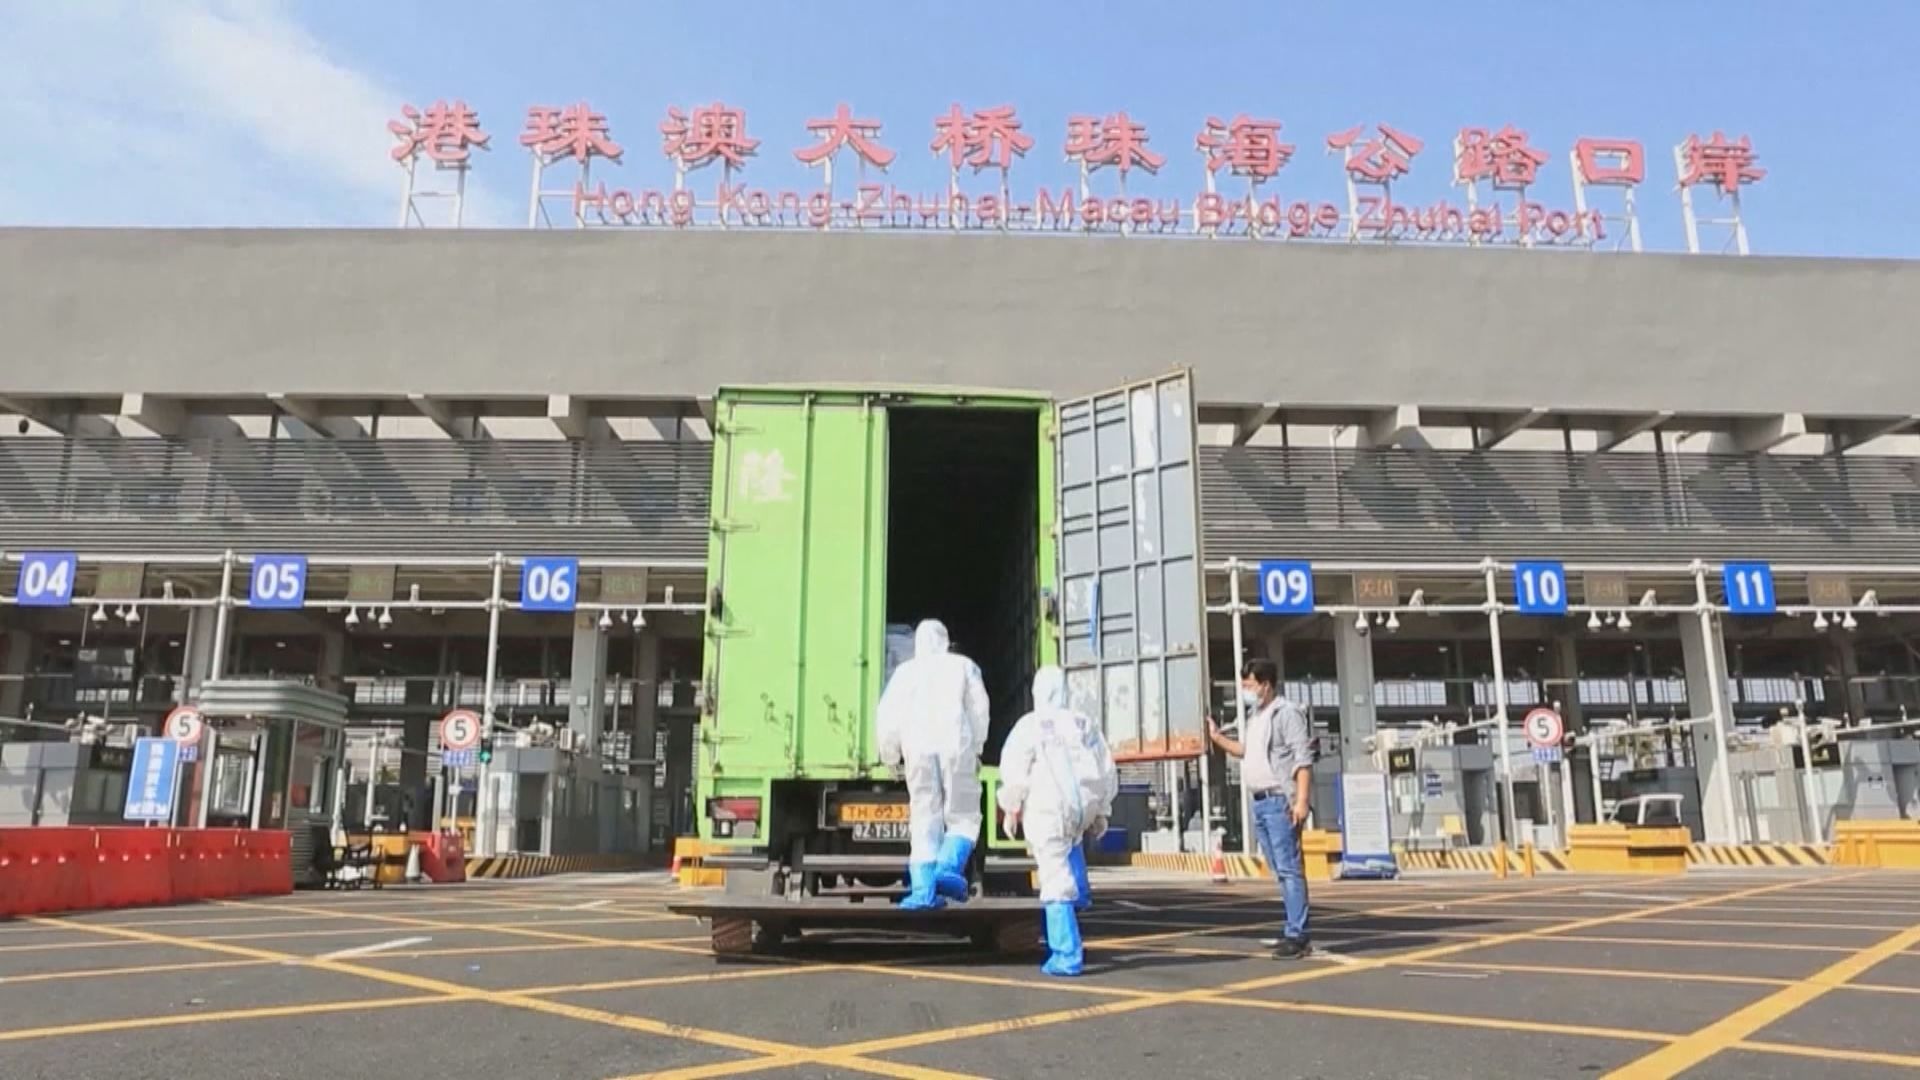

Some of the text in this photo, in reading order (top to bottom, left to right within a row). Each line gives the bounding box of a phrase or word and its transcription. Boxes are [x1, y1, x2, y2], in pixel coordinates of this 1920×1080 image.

[387, 99, 1767, 194] 港珠澳大桥珠海公路口岸
[574, 181, 694, 229] Hong
[1195, 192, 1340, 237] Bridge
[1356, 197, 1502, 236] Zhuhai
[1519, 202, 1607, 239] Port
[25, 560, 69, 597] 04
[256, 563, 299, 599] 05
[528, 566, 570, 602] 06
[1266, 569, 1308, 605] 09
[1522, 570, 1560, 605] 10
[1735, 571, 1765, 606] 11
[178, 715, 191, 737] 5
[455, 719, 467, 741] 5
[1537, 717, 1550, 738] 5
[847, 805, 868, 819] TH
